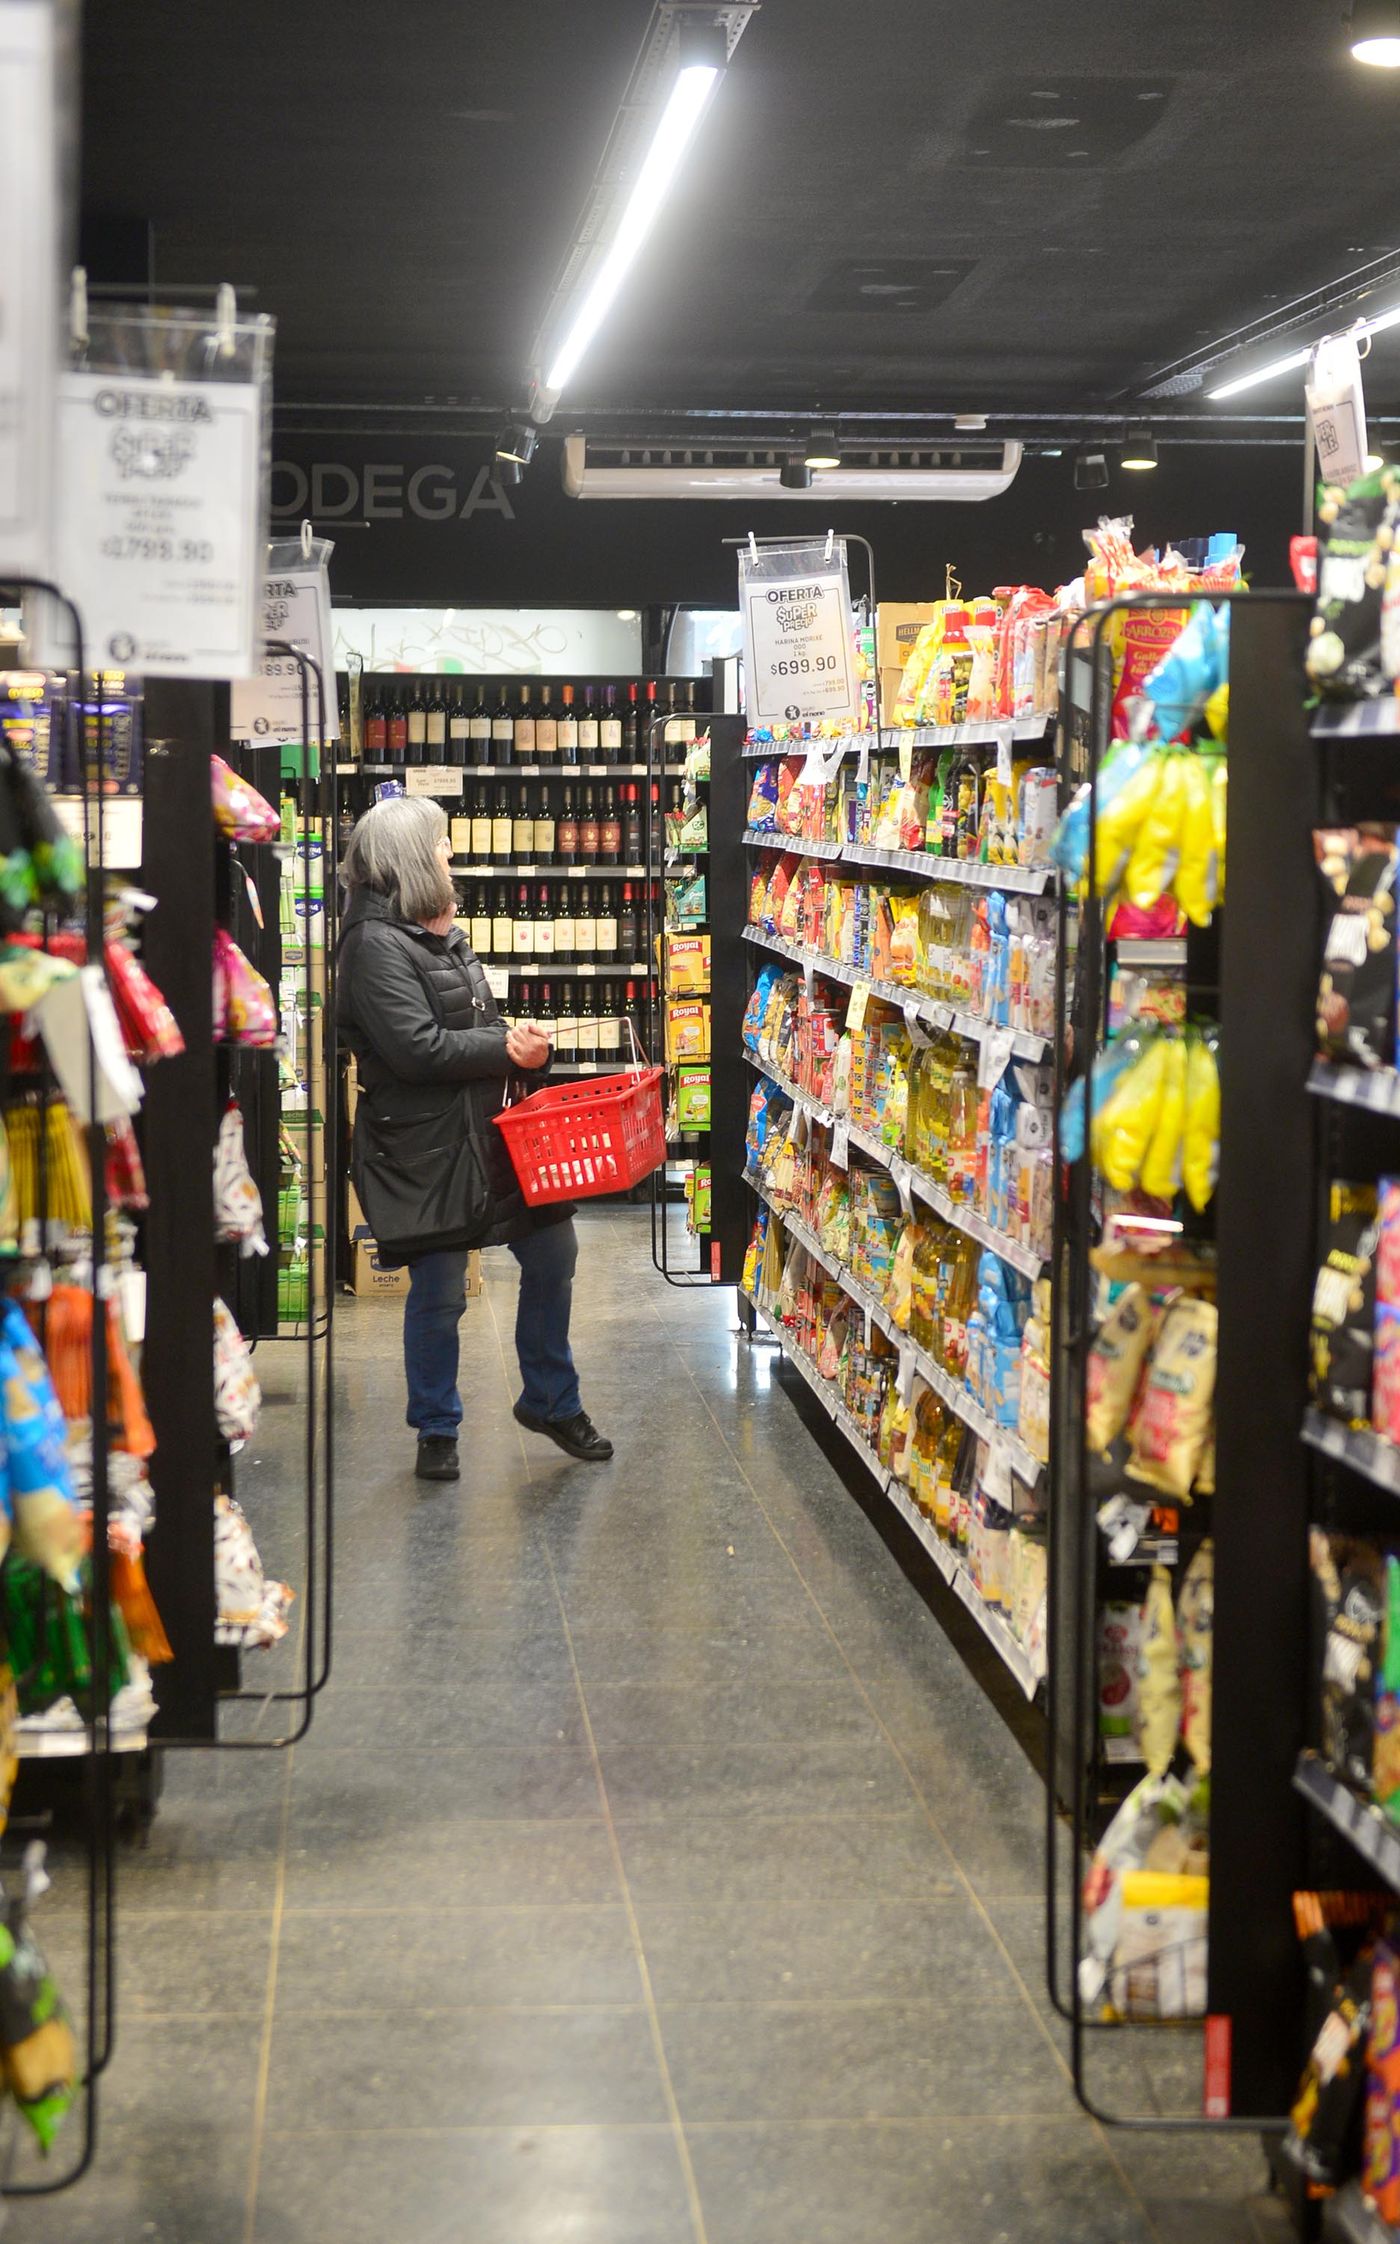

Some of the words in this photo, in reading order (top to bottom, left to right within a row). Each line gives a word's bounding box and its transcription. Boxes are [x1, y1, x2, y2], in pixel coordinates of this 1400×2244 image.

[94, 389, 214, 421] OFERTA
[269, 461, 516, 520] ODEGA
[767, 586, 823, 603] OFERTA
[775, 637, 798, 645] HARINA
[770, 655, 836, 676] $699.90
[672, 941, 699, 954] Royal
[672, 1006, 699, 1019] Royal
[683, 1074, 710, 1086] Royal
[372, 1275, 400, 1283] Leche
